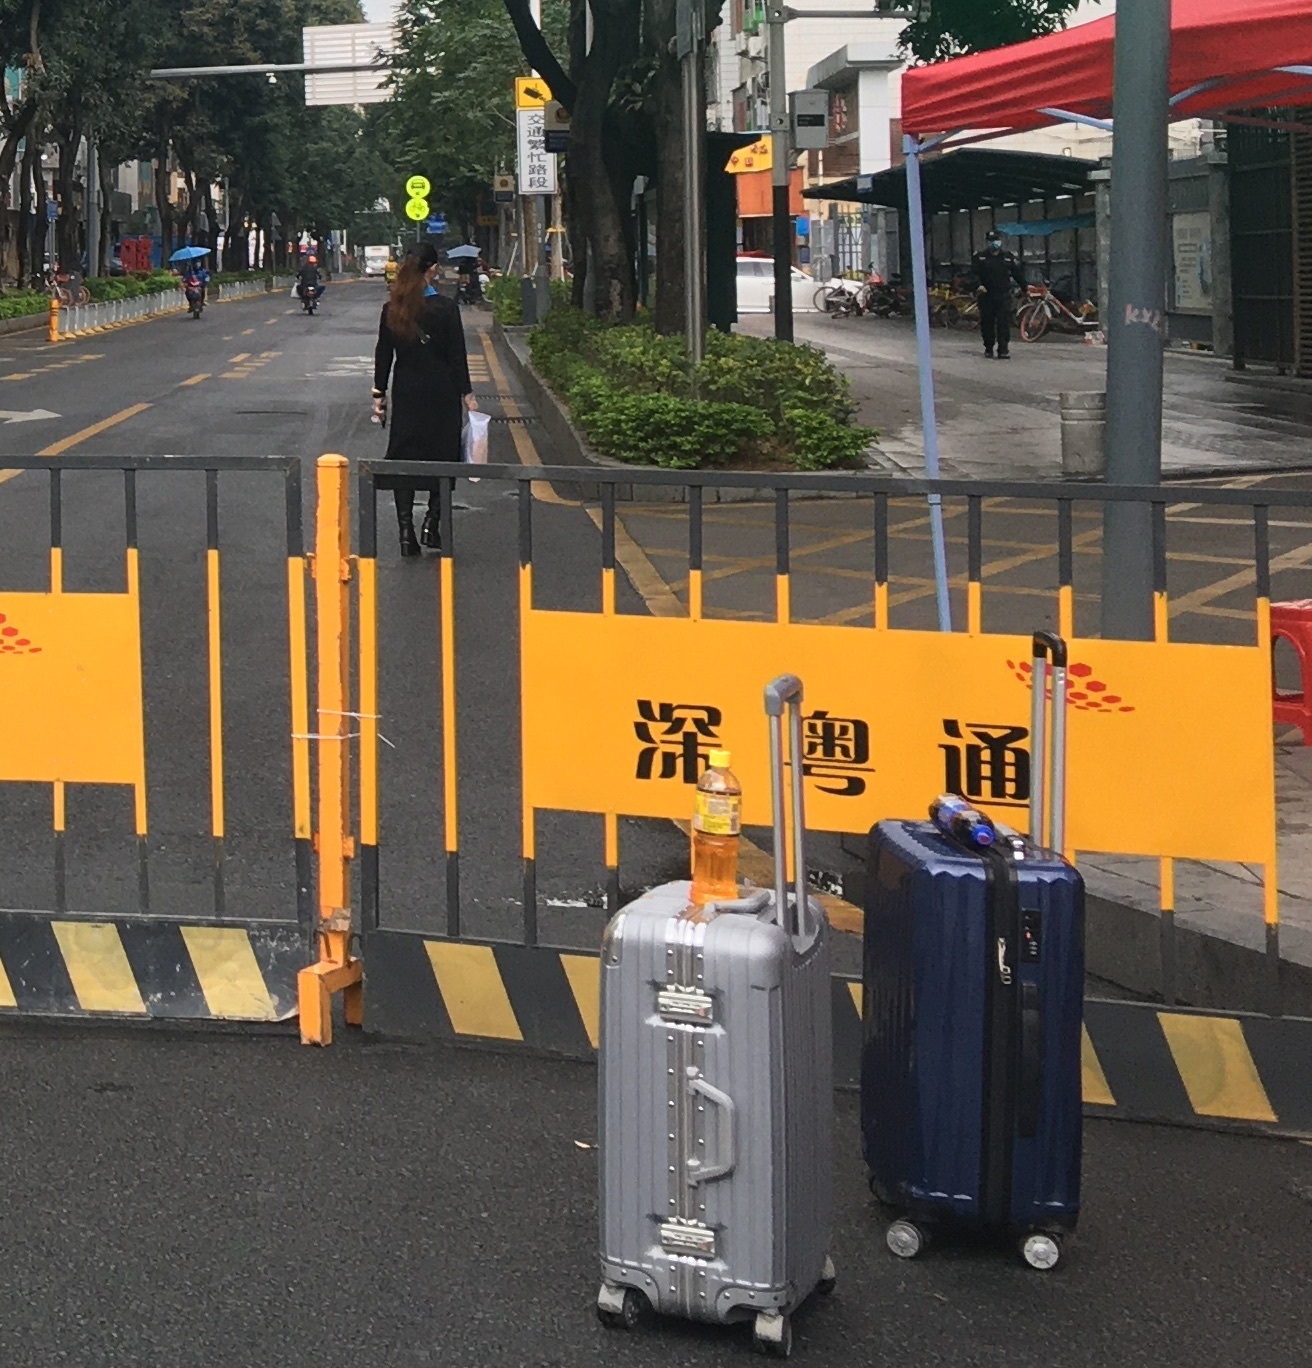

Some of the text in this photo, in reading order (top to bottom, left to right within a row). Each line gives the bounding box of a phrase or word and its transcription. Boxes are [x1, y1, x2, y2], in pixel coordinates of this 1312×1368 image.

[527, 113, 548, 189] 交通繁忙路段
[633, 698, 1032, 808] 深粤通
